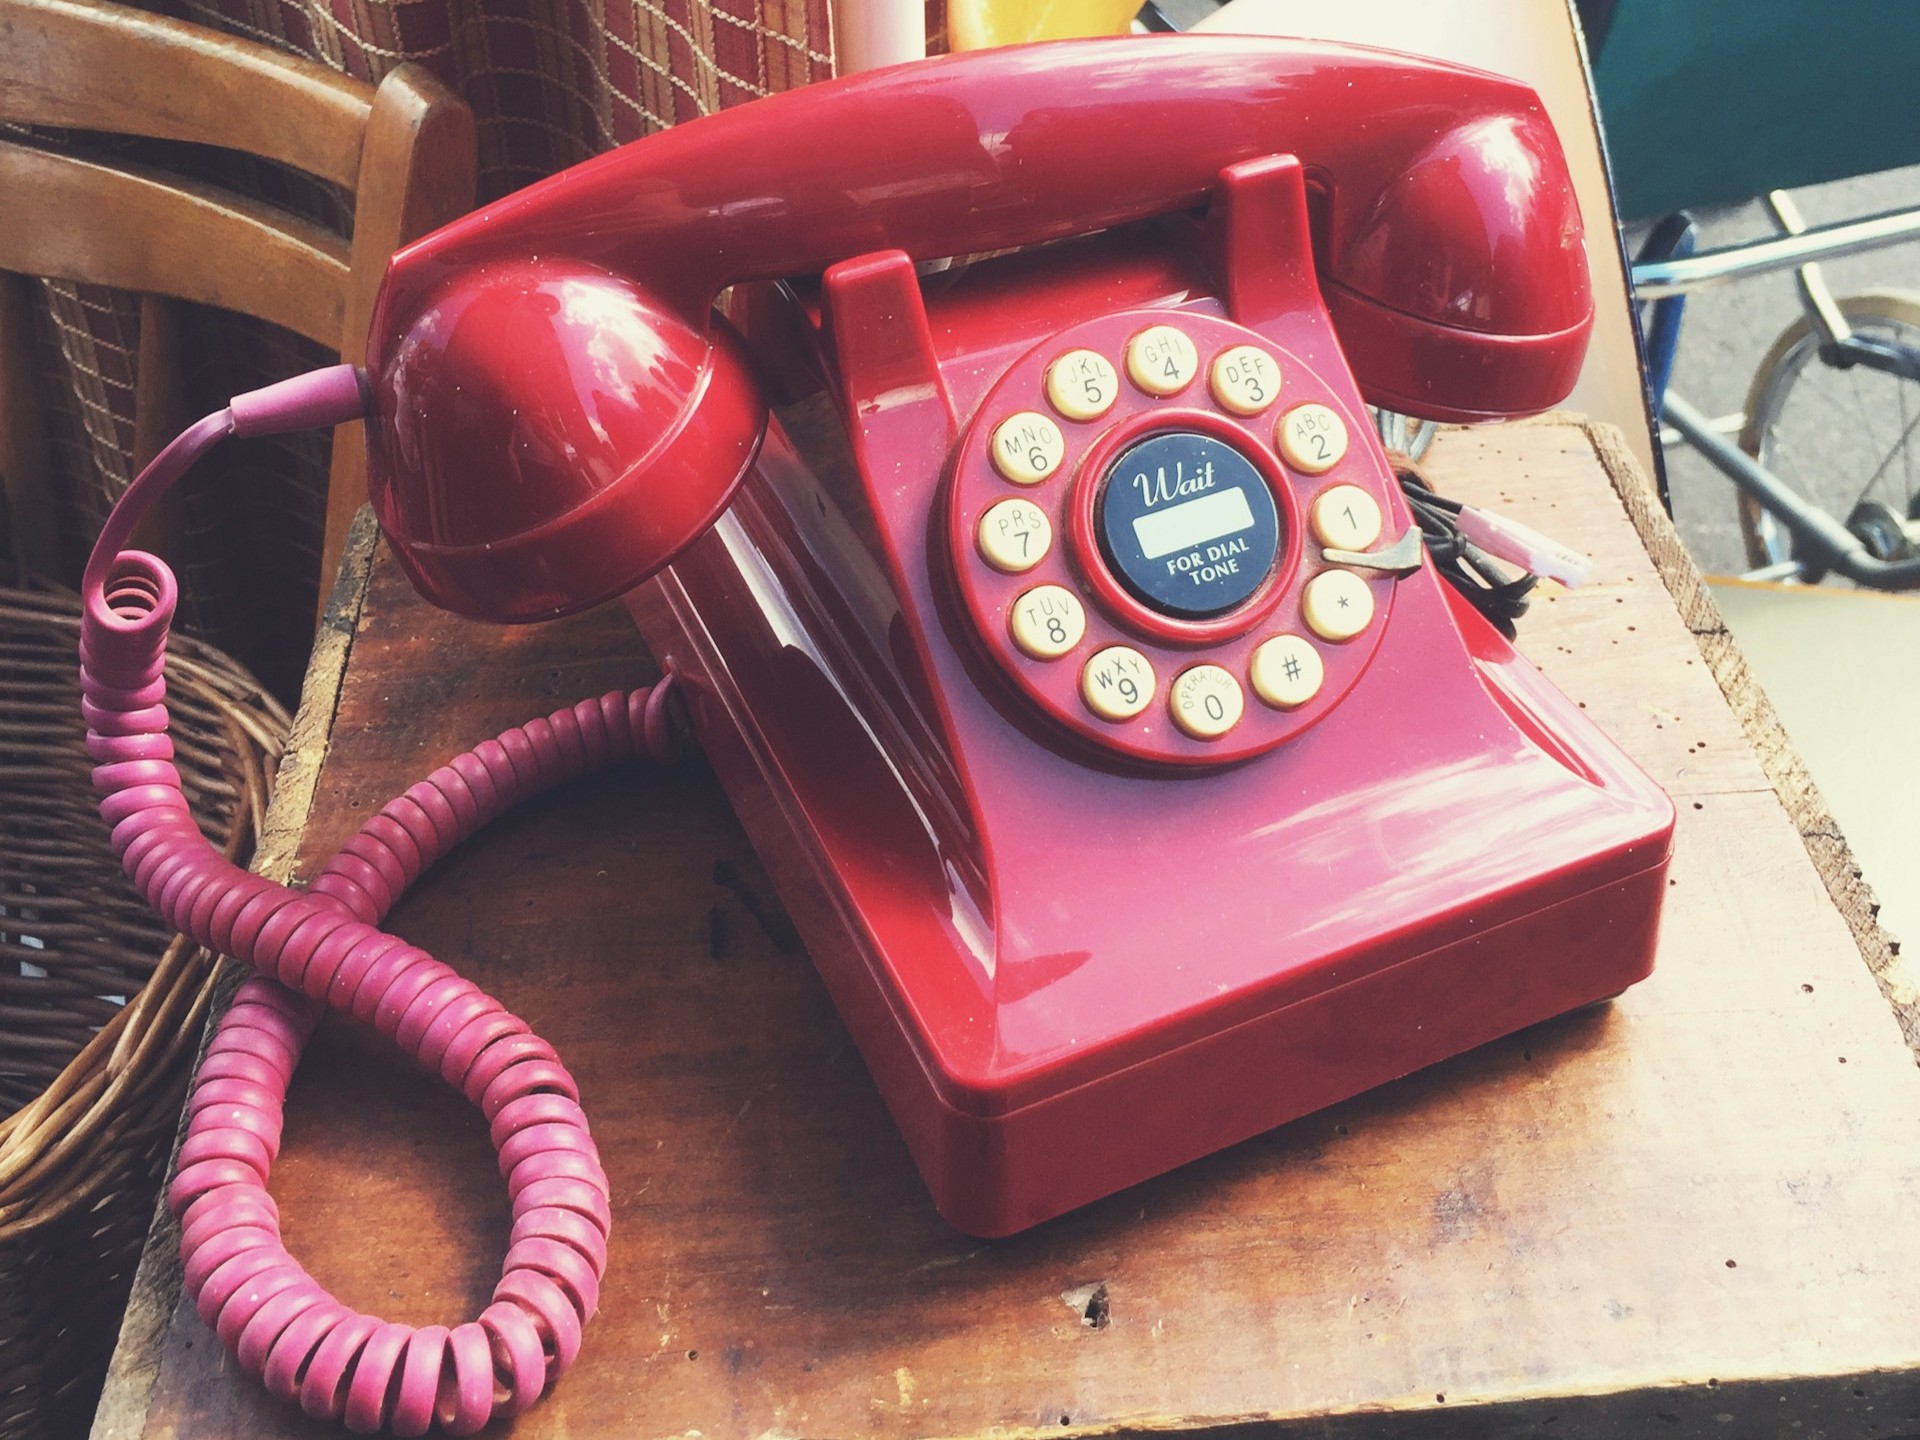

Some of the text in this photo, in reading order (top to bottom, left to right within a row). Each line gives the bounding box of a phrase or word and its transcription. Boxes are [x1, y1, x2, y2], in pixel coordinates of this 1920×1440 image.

[1144, 336, 1183, 363] GHI
[1070, 357, 1108, 383] JKL
[1164, 356, 1180, 379] 4
[1226, 356, 1264, 383] DEF
[1084, 378, 1102, 403] 5
[1245, 377, 1264, 402] 3
[1295, 413, 1331, 439] ABC
[1005, 426, 1052, 456] MNO
[1311, 435, 1331, 460] 2
[1029, 446, 1048, 471] 6
[1132, 461, 1216, 507] Wait
[998, 509, 1041, 536] PRS
[1343, 506, 1357, 530] 1
[1013, 531, 1030, 558] 7
[1166, 537, 1249, 576] FOR DIAL
[1189, 558, 1240, 585] TONE
[1026, 597, 1069, 627] TUV
[1047, 618, 1066, 643] 8
[1095, 656, 1142, 689] WXY
[1282, 654, 1301, 682] #
[1118, 678, 1138, 704] 9
[1182, 668, 1232, 710] OPERATOR
[1205, 694, 1223, 720] 0
